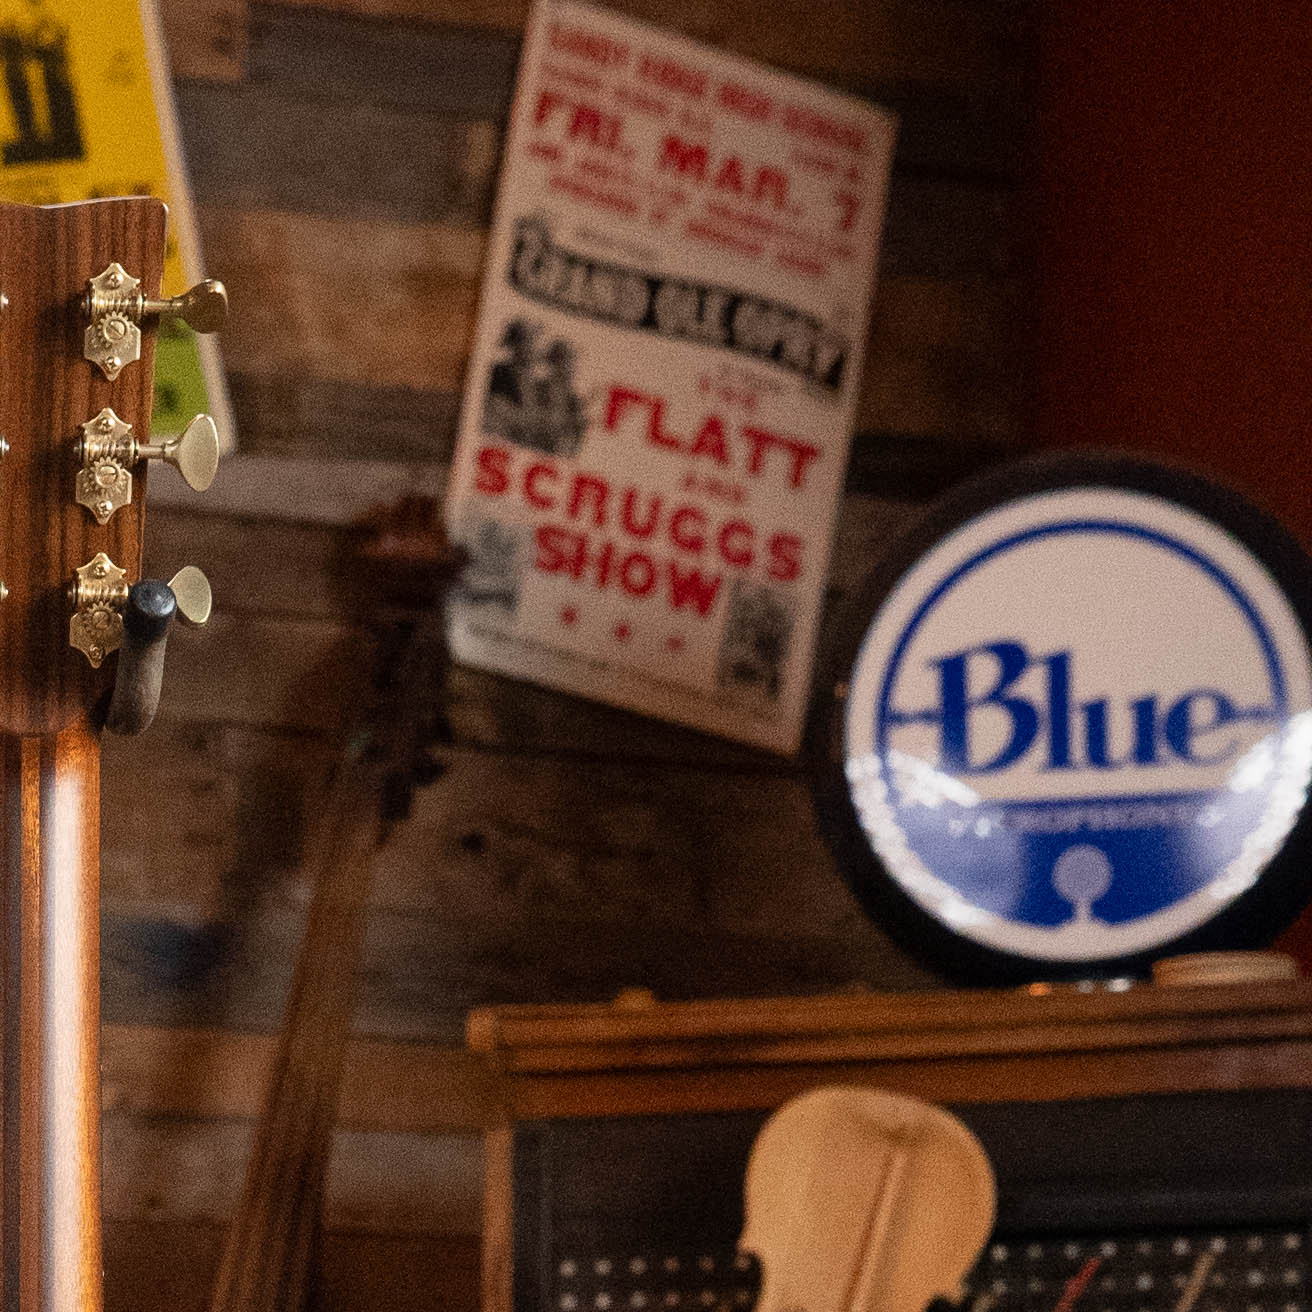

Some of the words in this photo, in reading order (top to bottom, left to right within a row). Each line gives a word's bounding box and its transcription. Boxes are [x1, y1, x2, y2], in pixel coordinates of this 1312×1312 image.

[602, 386, 820, 489] FLATT
[475, 446, 804, 581] SCRUGGS
[533, 525, 721, 616] SHOW
[928, 639, 1242, 773] Blue
